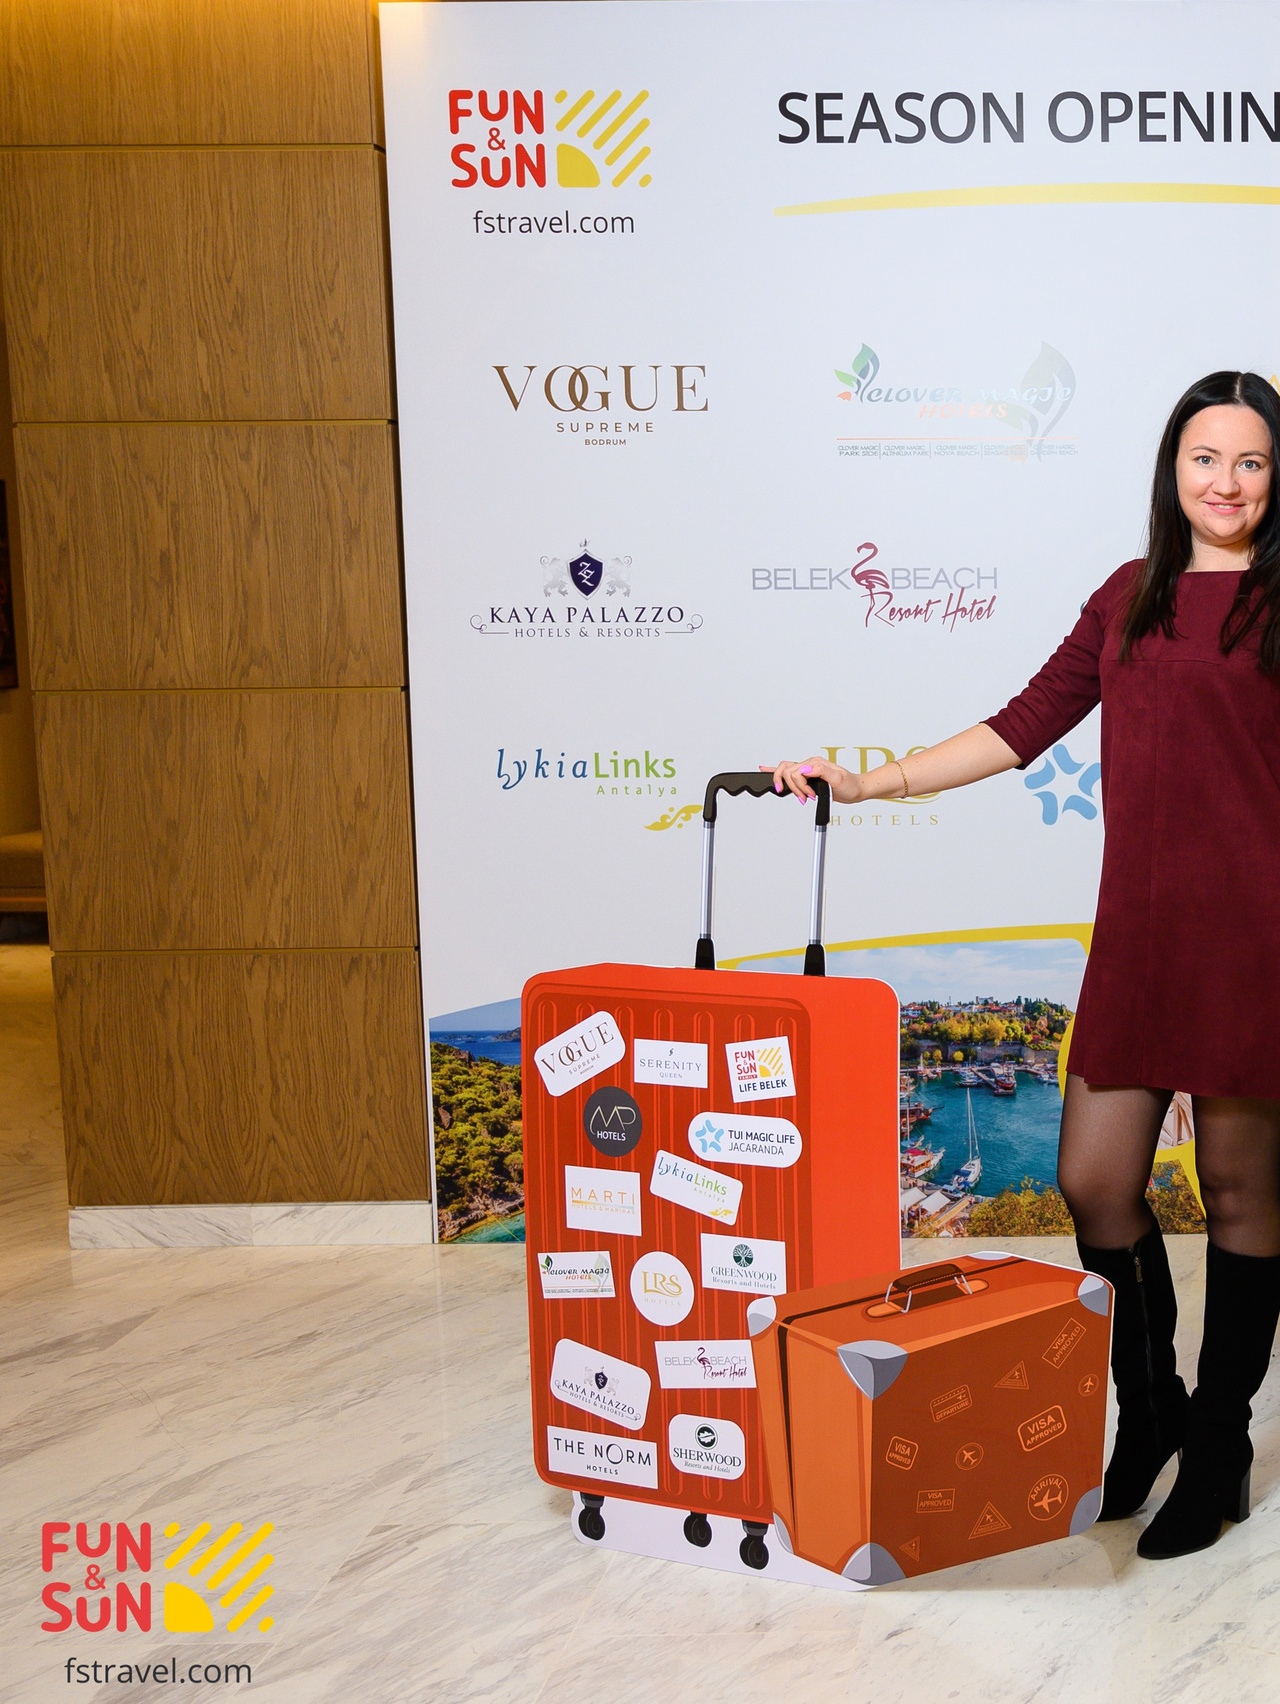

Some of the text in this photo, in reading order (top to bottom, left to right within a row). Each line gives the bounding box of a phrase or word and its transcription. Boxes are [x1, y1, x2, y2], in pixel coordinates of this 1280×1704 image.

[448, 89, 544, 135] FUN
[777, 90, 1026, 145] SEASON
[487, 127, 506, 151] &
[450, 143, 546, 188] SUN
[472, 210, 635, 234] fstravel.com
[491, 364, 710, 413] VOGUE
[866, 386, 1073, 403] CLOVER MAGIC
[919, 403, 1008, 419] HOTELS
[556, 421, 654, 433] SUPREME
[584, 438, 627, 446] BODRUM
[752, 566, 998, 591] BELEK BEACH
[489, 606, 685, 624] KAYA PALAZZO
[865, 588, 998, 633] Resort Hotel
[514, 627, 661, 638] HOTELS & RESORTS
[596, 785, 678, 797] Antalya
[830, 814, 940, 826] HOTELS
[541, 1022, 614, 1074] VOGUE
[734, 1050, 755, 1062] FUN
[568, 1053, 601, 1075] SUPREME
[639, 1058, 703, 1072] SERENITY
[736, 1063, 757, 1075] SUN
[739, 1079, 788, 1093] LIFE BELEK
[590, 1105, 636, 1135] MP
[597, 1130, 626, 1142] HOTELS
[728, 1130, 795, 1145] TUI MAGIC LIFE
[728, 1142, 784, 1156] JACARANDA
[571, 1186, 635, 1206] MARTI
[711, 1266, 777, 1282] GREENWOOD
[642, 1271, 683, 1298] LRS
[712, 1276, 737, 1285] Resorts
[754, 1281, 776, 1290] Hotels
[1052, 1333, 1068, 1350] VISA
[1052, 1326, 1080, 1364] APPROVED
[664, 1356, 747, 1366] BELEK BEACH
[562, 1379, 635, 1415] KAYA PALAZZO
[935, 1400, 970, 1420] DEPARTURE
[1027, 1414, 1056, 1434] VISA
[1026, 1422, 1062, 1446] APPROVED
[554, 1437, 652, 1466] THE NORM
[673, 1447, 742, 1467] SHERWOOD
[894, 1442, 911, 1456] VISA
[889, 1451, 911, 1465] APPROVED
[586, 1464, 619, 1476] HOTELS
[1030, 1478, 1063, 1501] ARRIVAL
[919, 1499, 952, 1507] APPROVED
